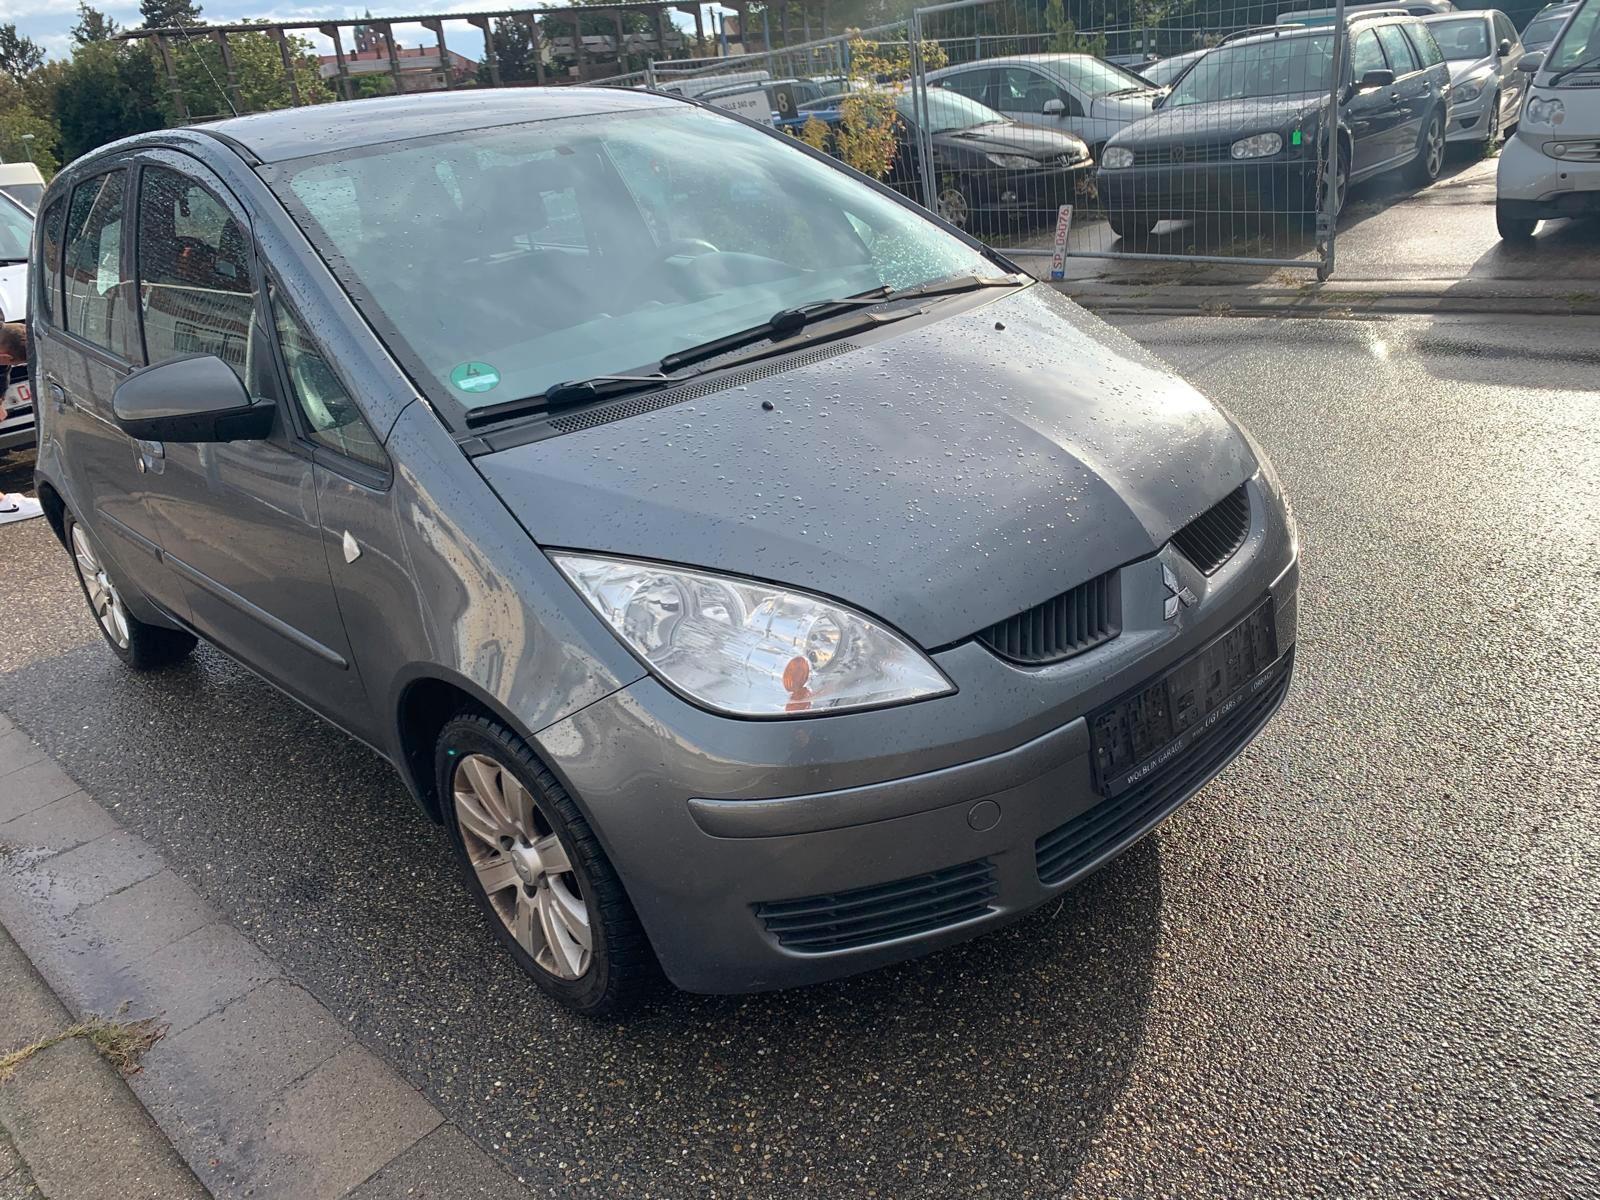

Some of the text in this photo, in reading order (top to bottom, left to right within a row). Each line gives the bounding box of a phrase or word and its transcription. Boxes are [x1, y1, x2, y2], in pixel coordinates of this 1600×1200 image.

[777, 92, 789, 112] 8
[1053, 254, 1063, 269] SP
[466, 364, 480, 376] 4
